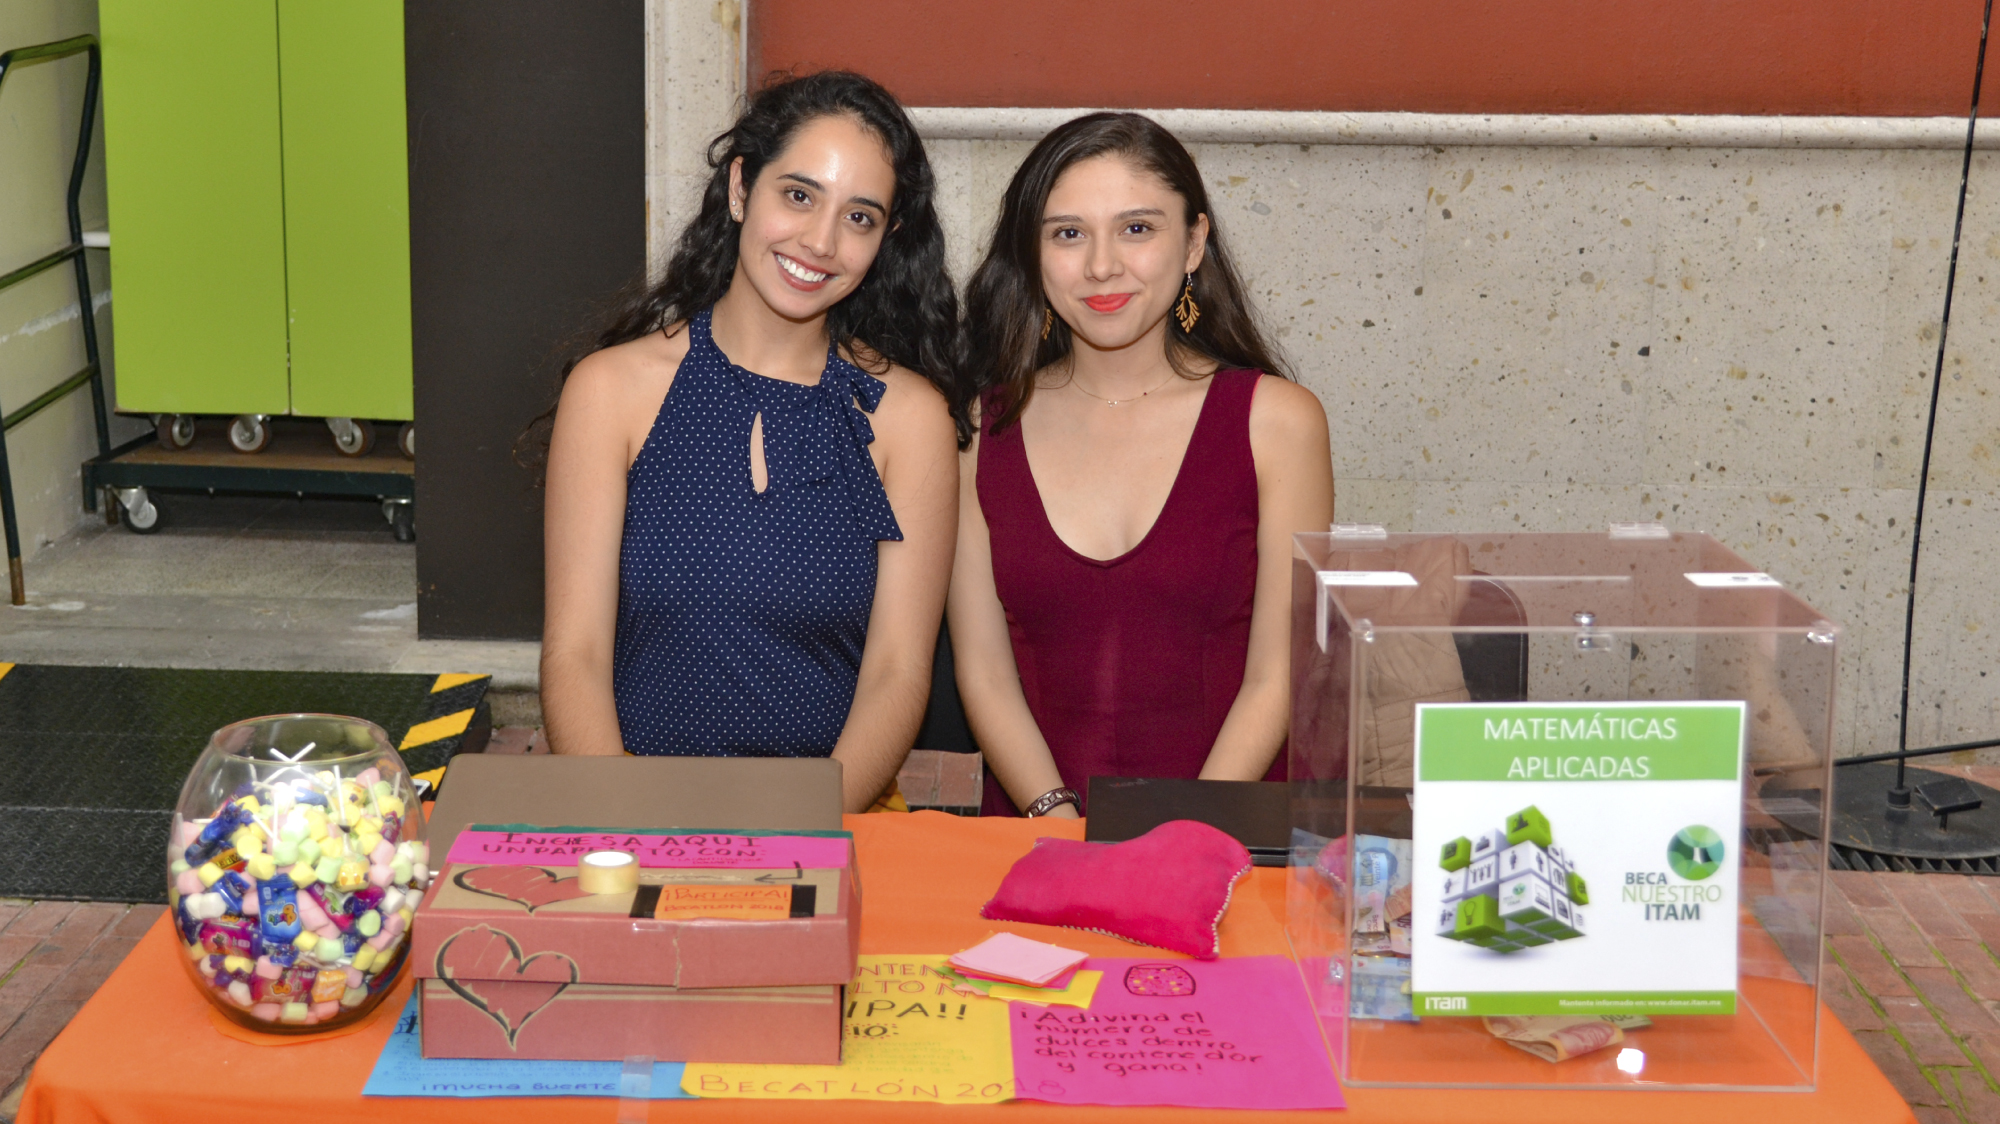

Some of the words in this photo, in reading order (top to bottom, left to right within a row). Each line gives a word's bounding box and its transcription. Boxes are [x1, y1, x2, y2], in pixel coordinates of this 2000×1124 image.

[1484, 712, 1677, 740] MATEMÁTICAS
[1506, 756, 1650, 779] APLICADAS
[500, 832, 643, 847] INGRESA
[660, 835, 761, 848] AQUI
[1373, 859, 1381, 885] Veinte
[1625, 872, 1668, 885] BECA
[1622, 885, 1722, 903] NUESTRO
[749, 904, 785, 912] 2018
[1645, 903, 1701, 921] ITAM
[1595, 999, 1634, 1007] informado
[1180, 1012, 1205, 1024] el
[1173, 1026, 1213, 1038] de
[1035, 1035, 1128, 1048] dulces
[1142, 1036, 1236, 1051] dentro
[1034, 1047, 1077, 1059] del
[1057, 1061, 1075, 1073] y
[699, 1074, 940, 1098] BECATLÓN
[956, 1076, 1067, 1099] 2018
